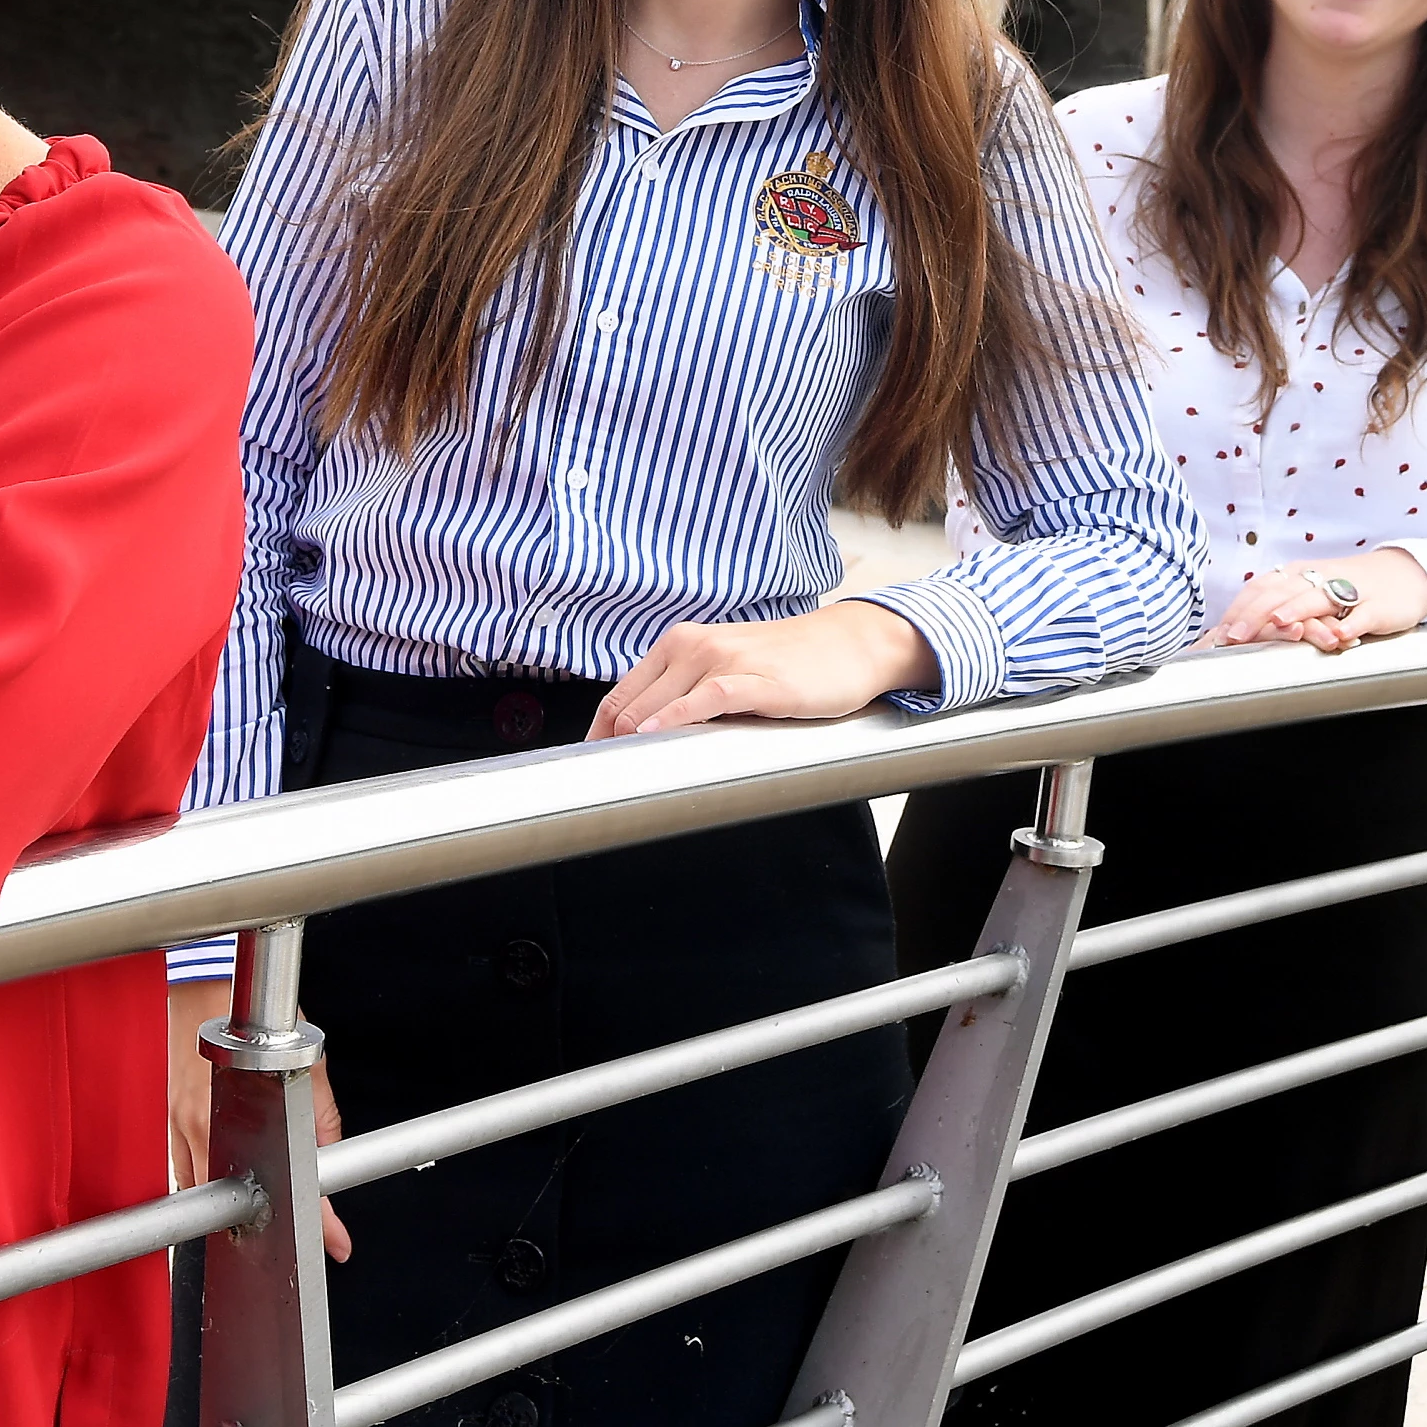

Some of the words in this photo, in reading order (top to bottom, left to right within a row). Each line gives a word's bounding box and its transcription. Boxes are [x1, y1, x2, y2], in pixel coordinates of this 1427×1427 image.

[787, 189, 819, 201] RALPH
[818, 198, 842, 231] LAUREN
[752, 261, 813, 283] CRUISER
[785, 256, 830, 275] CLASS
[775, 279, 817, 299] RLYC
